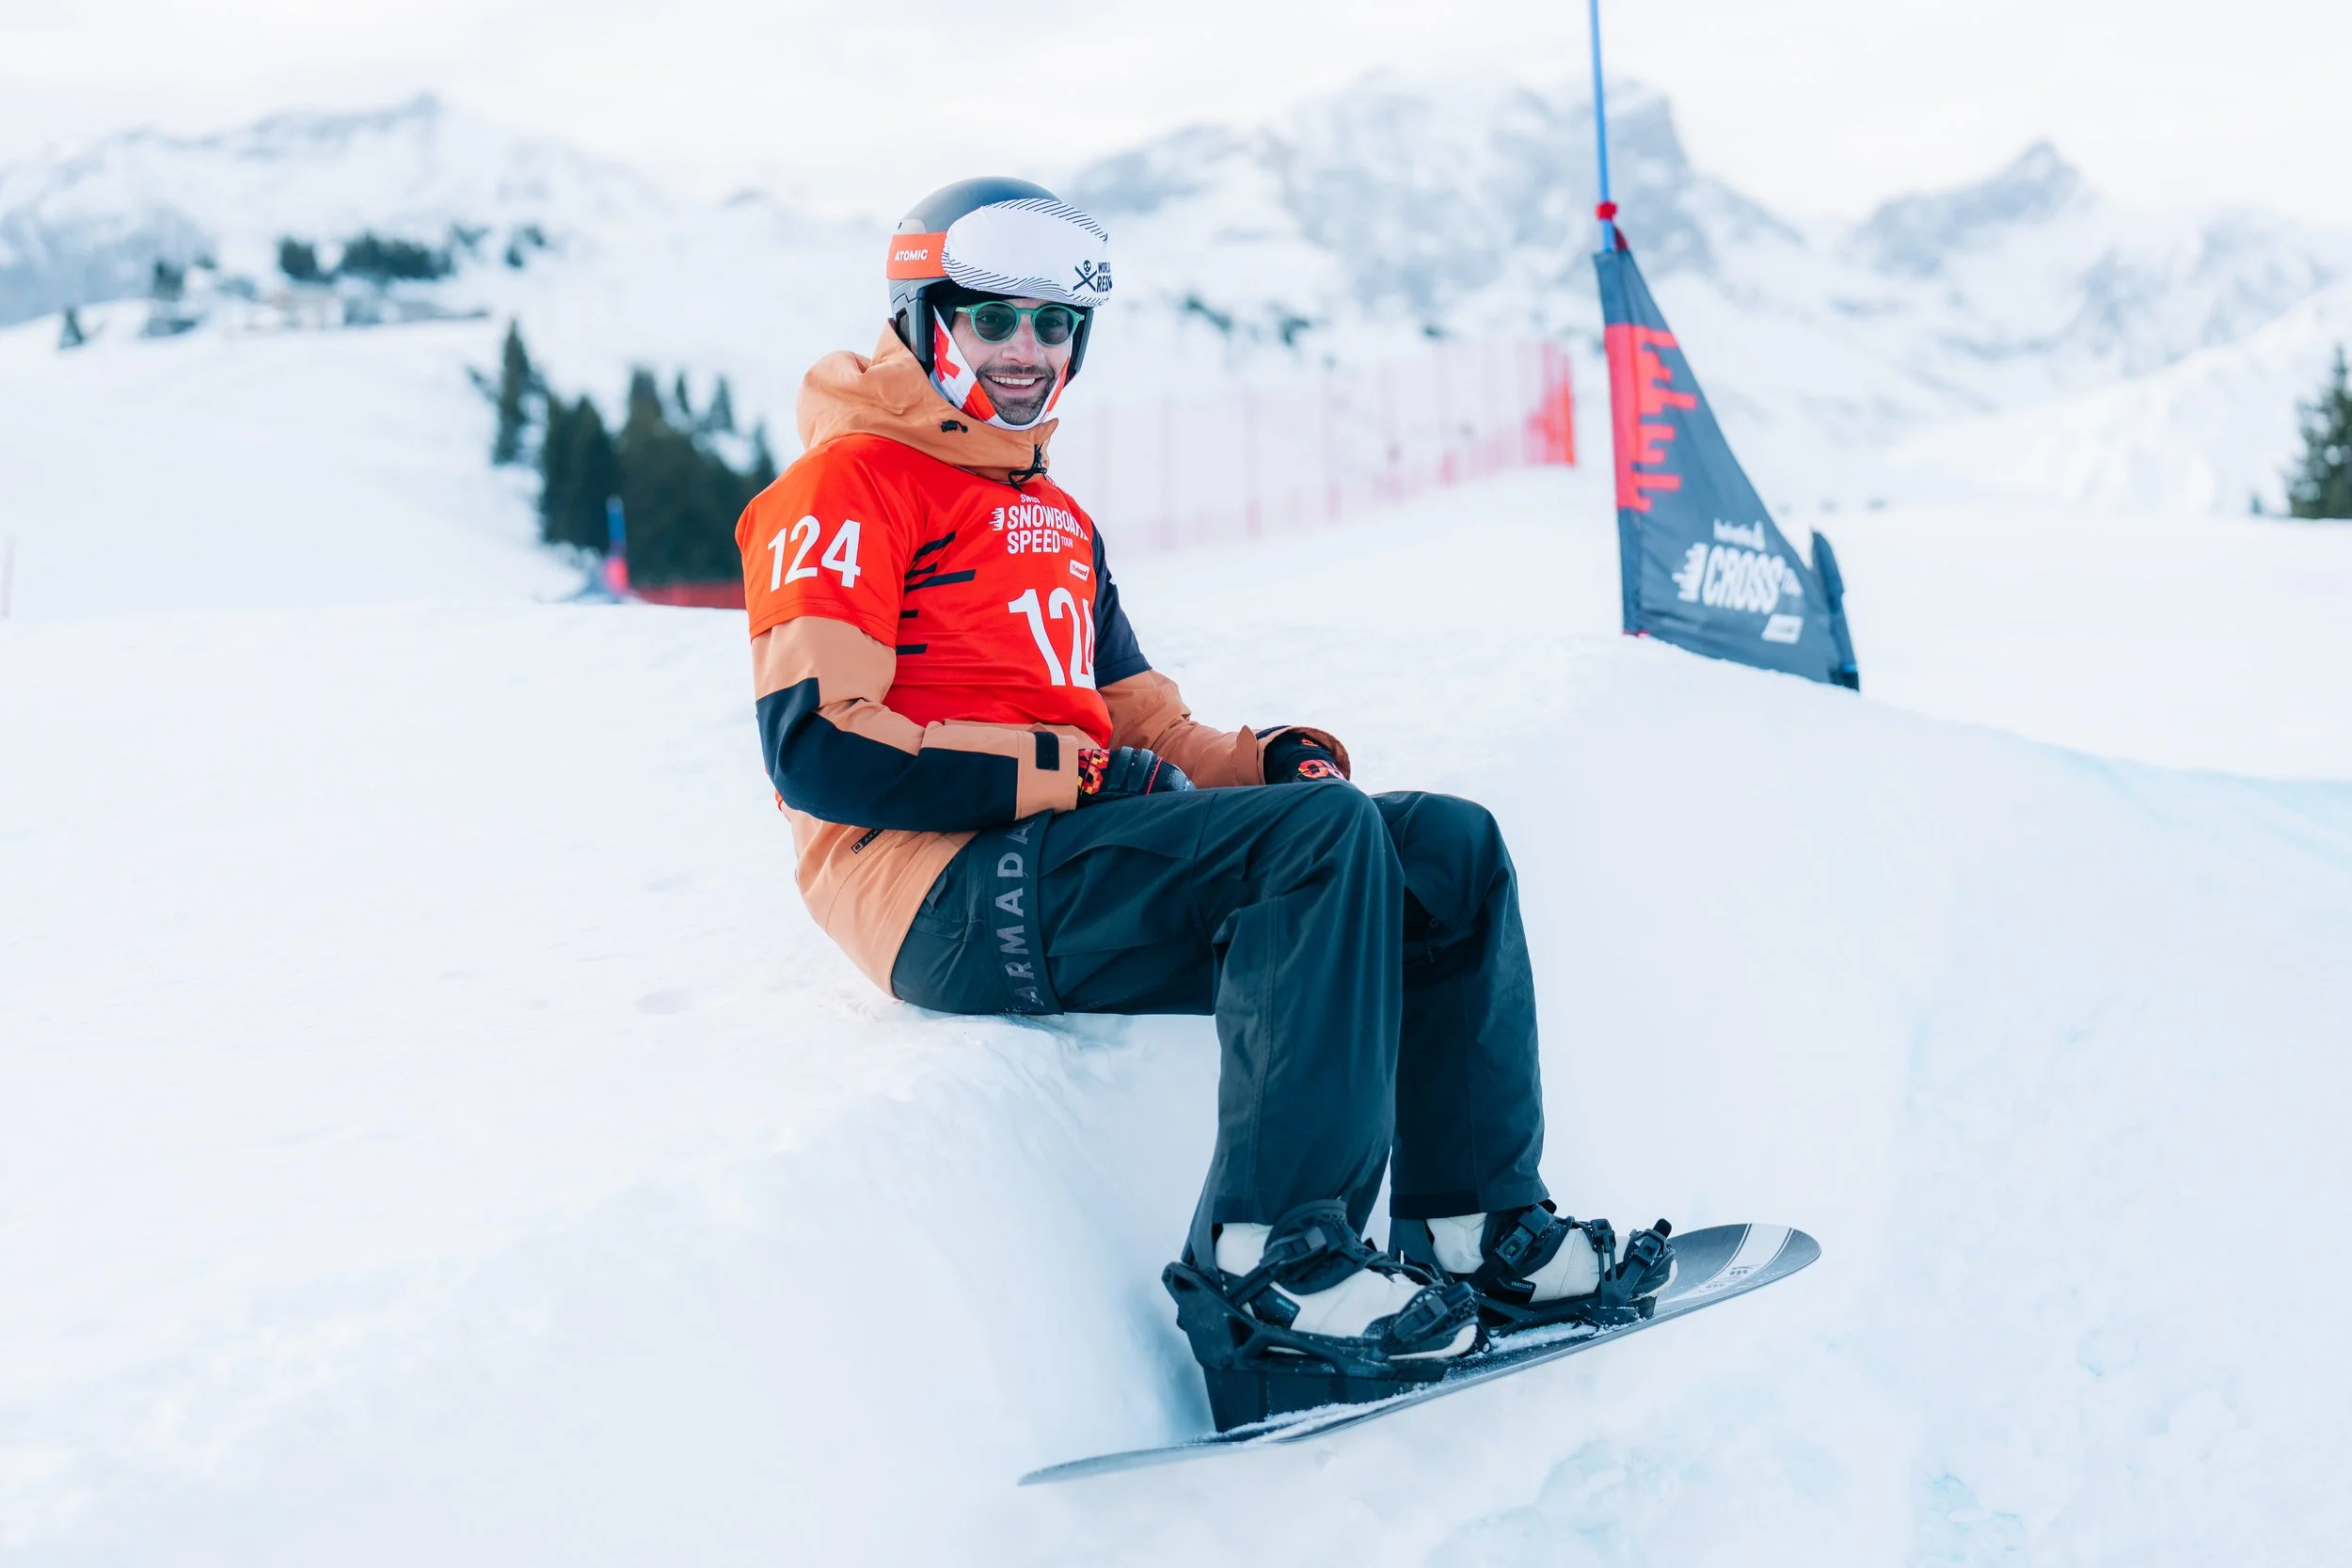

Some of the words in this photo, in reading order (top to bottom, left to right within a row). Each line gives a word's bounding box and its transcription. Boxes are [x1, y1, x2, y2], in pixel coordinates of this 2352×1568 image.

[894, 248, 929, 262] ATOMIC
[767, 515, 862, 593] 124
[1007, 529, 1061, 554] SPEED
[1702, 545, 1788, 616] CROSS
